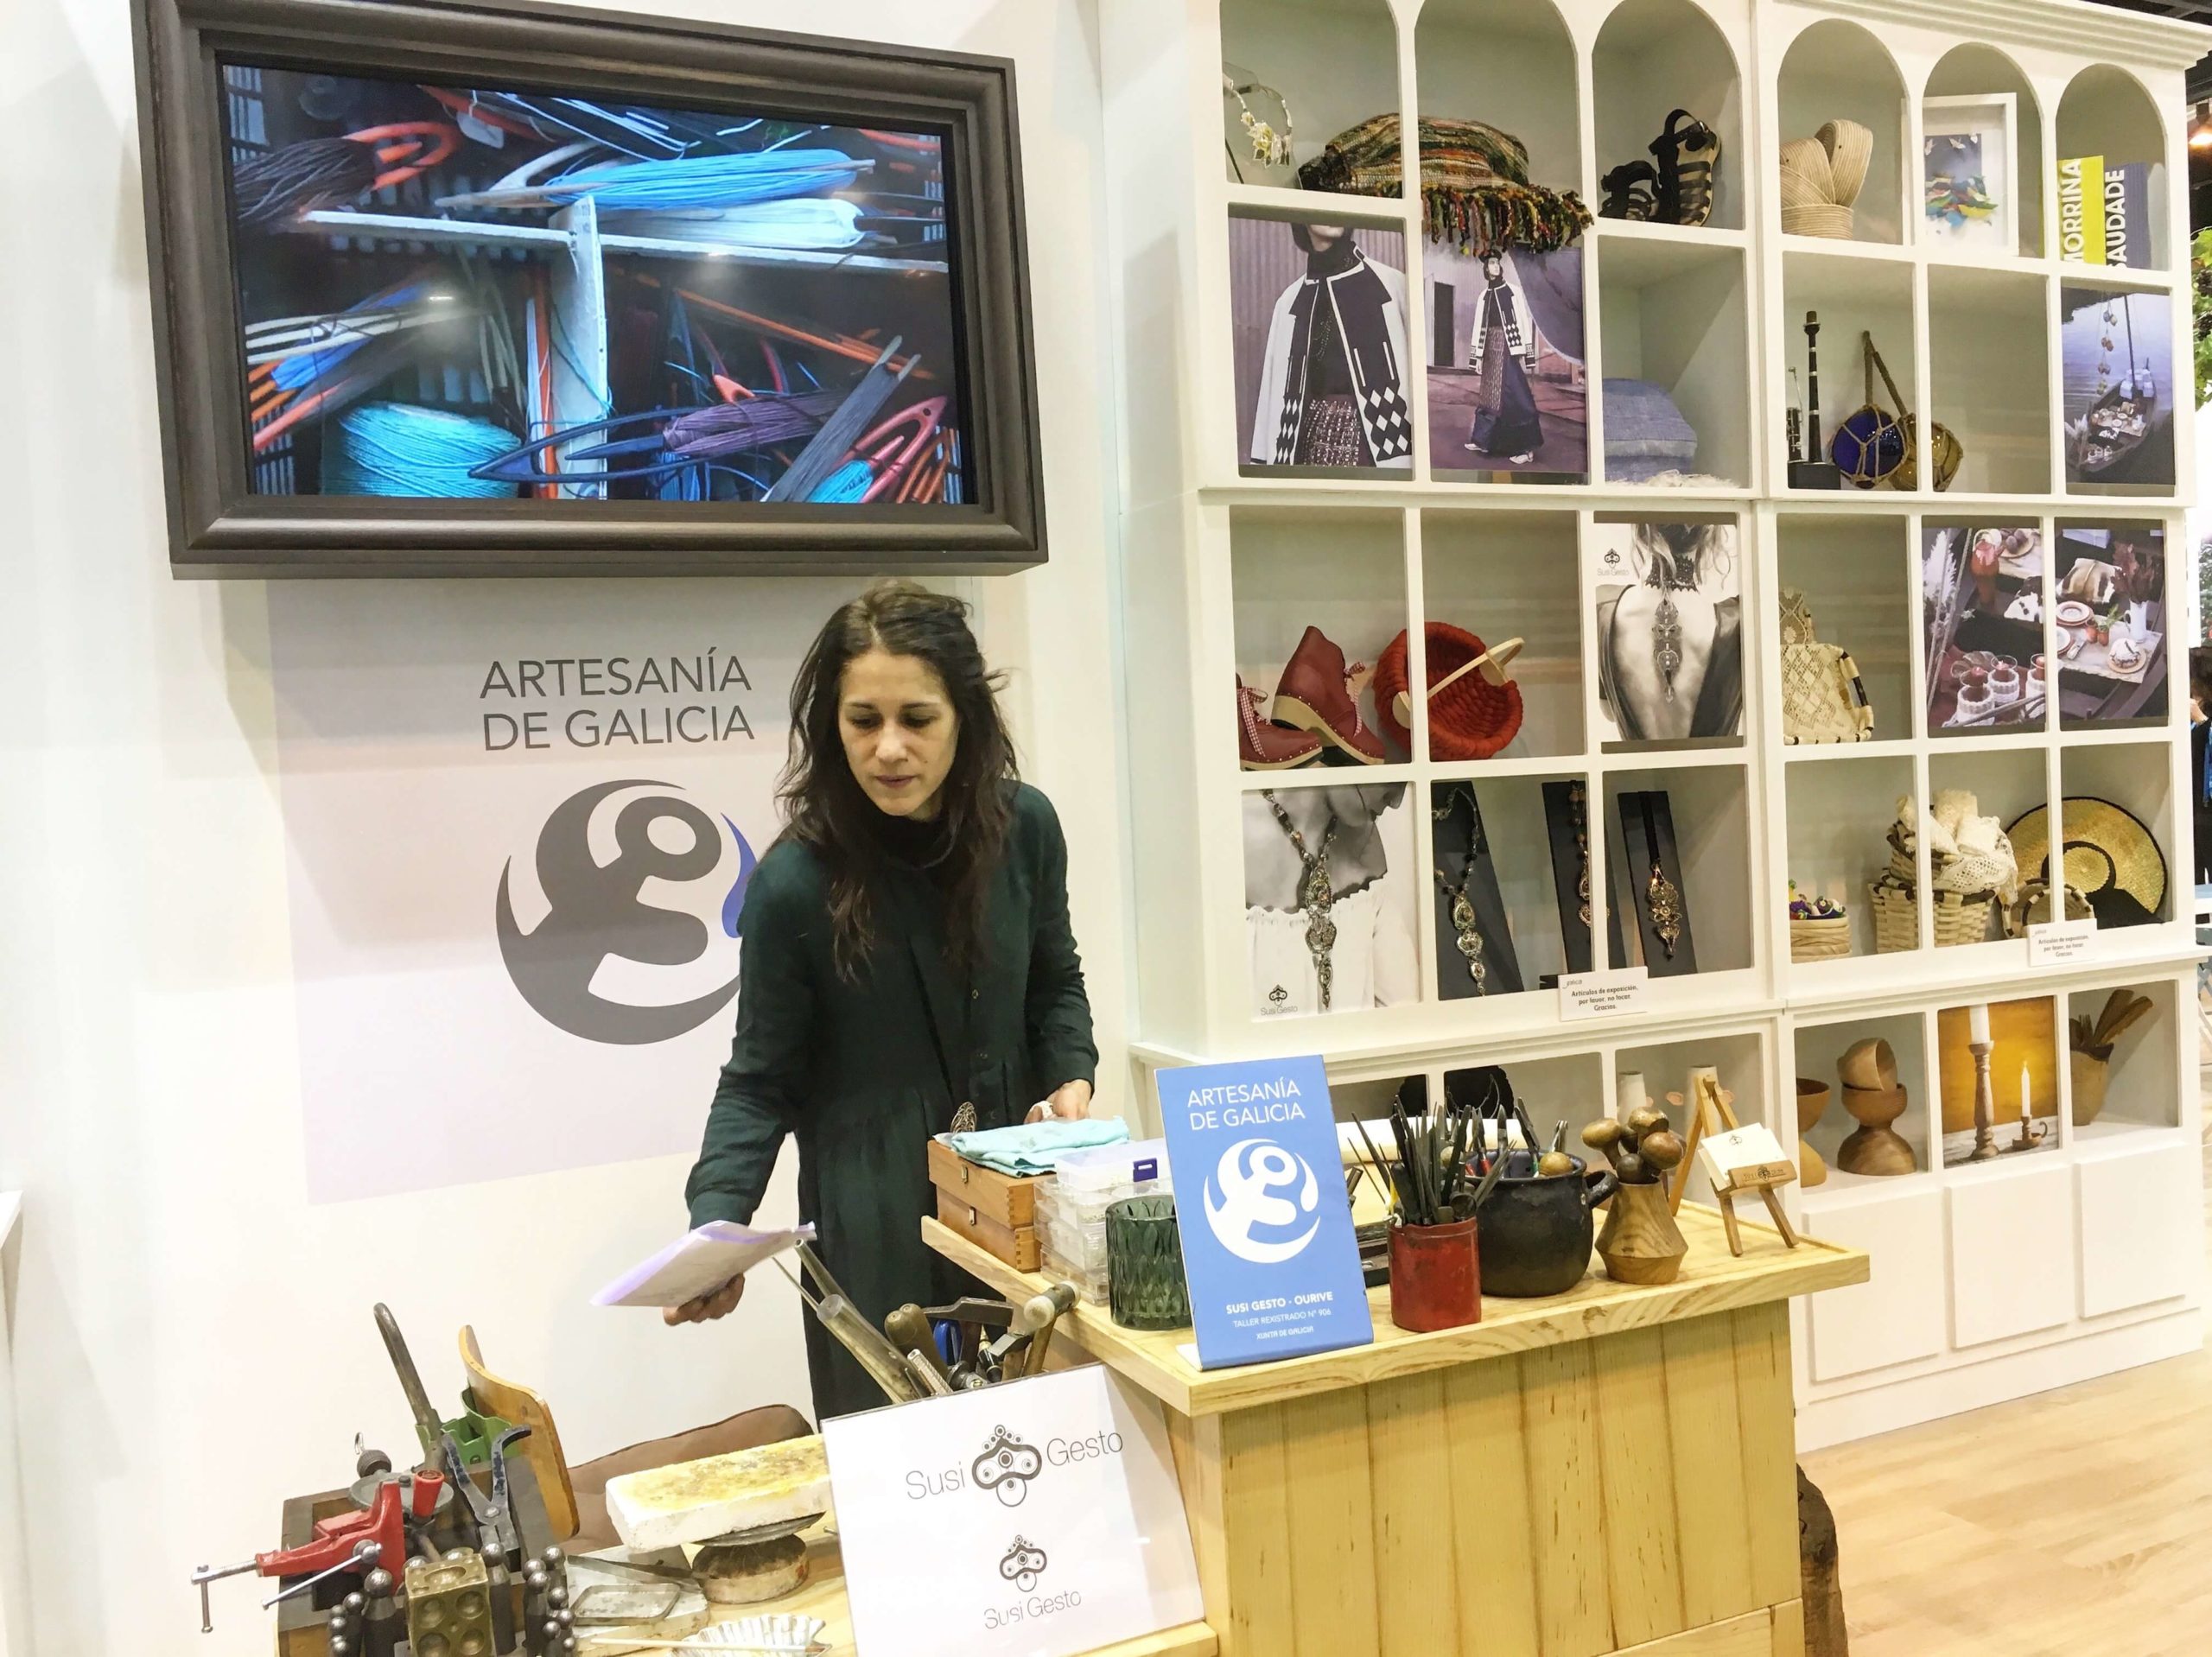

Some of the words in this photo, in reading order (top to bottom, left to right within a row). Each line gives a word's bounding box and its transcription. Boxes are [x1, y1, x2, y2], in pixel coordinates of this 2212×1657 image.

[480, 647, 752, 699] ARTESANÍA
[484, 712, 551, 751] DE
[564, 705, 755, 747] GALICIA
[1187, 1077, 1301, 1108] ARTESANÍA
[1190, 1110, 1219, 1131] DE
[1223, 1101, 1306, 1127] GALICIA
[1226, 1302, 1249, 1314] SUSI
[1251, 1298, 1286, 1311] GESTO
[1294, 1292, 1333, 1305] OURIVE
[1233, 1317, 1259, 1328] TALLER
[1261, 1311, 1306, 1324] REXISTRADO
[1318, 1308, 1332, 1317] 906
[1256, 1330, 1278, 1340] XUNTA
[1287, 1326, 1314, 1336] GALICIA
[906, 1461, 965, 1500] Susi
[1046, 1430, 1123, 1467] Gesto
[983, 1600, 1024, 1629] Susi
[1027, 1589, 1082, 1619] Gesto
